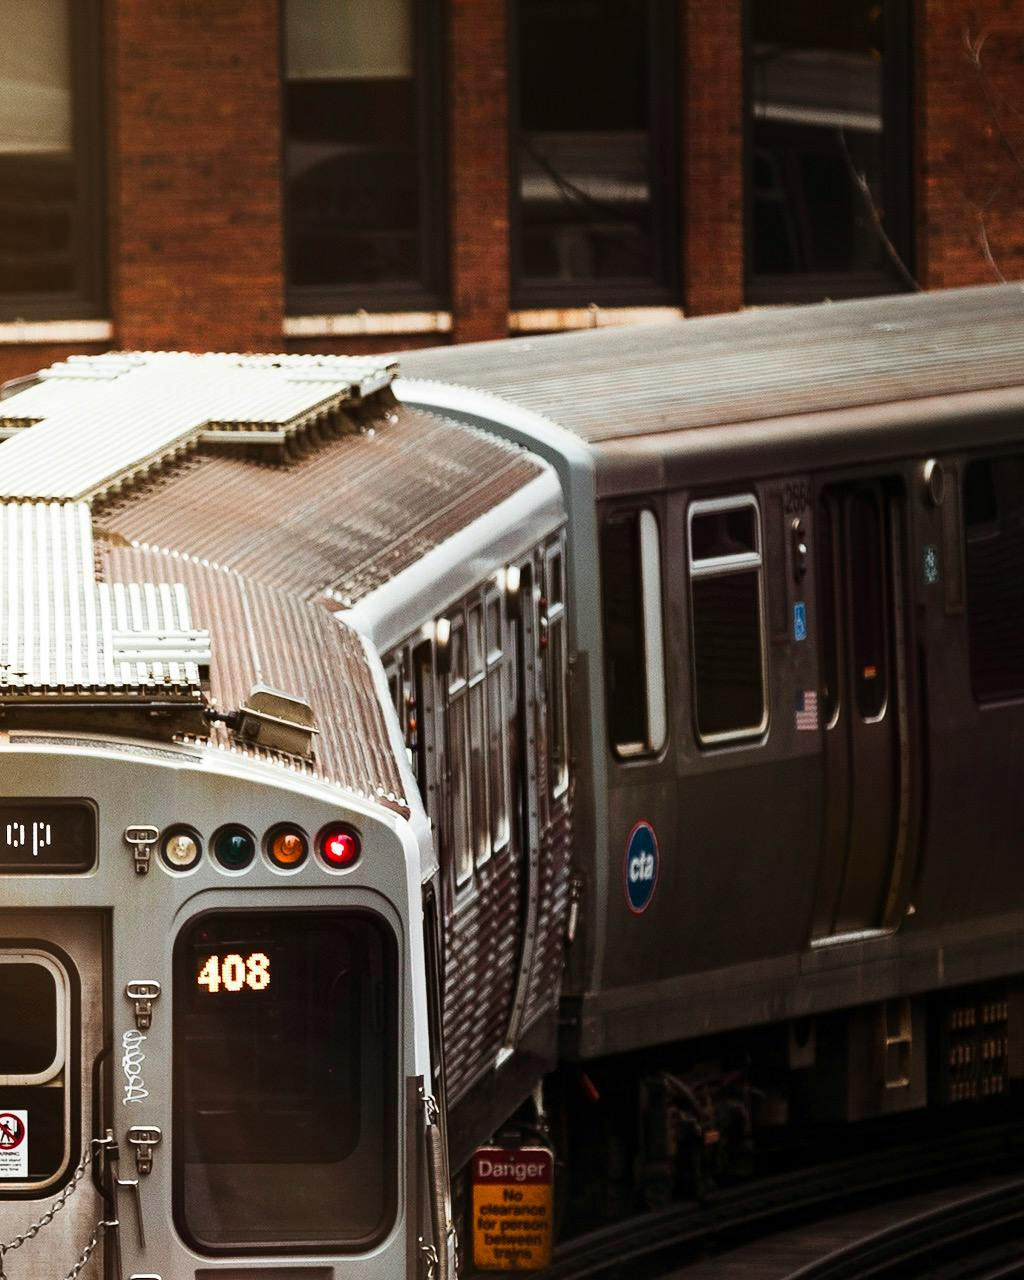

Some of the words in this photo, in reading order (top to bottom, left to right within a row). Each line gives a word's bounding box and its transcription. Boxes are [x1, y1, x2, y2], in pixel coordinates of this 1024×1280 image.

[629, 851, 655, 883] cta
[197, 952, 271, 993] 408
[478, 1160, 546, 1182] Danger
[503, 1189, 523, 1202] No
[479, 1203, 546, 1216] clearance
[478, 1216, 497, 1230] for
[500, 1219, 547, 1234] person
[484, 1232, 543, 1246] between
